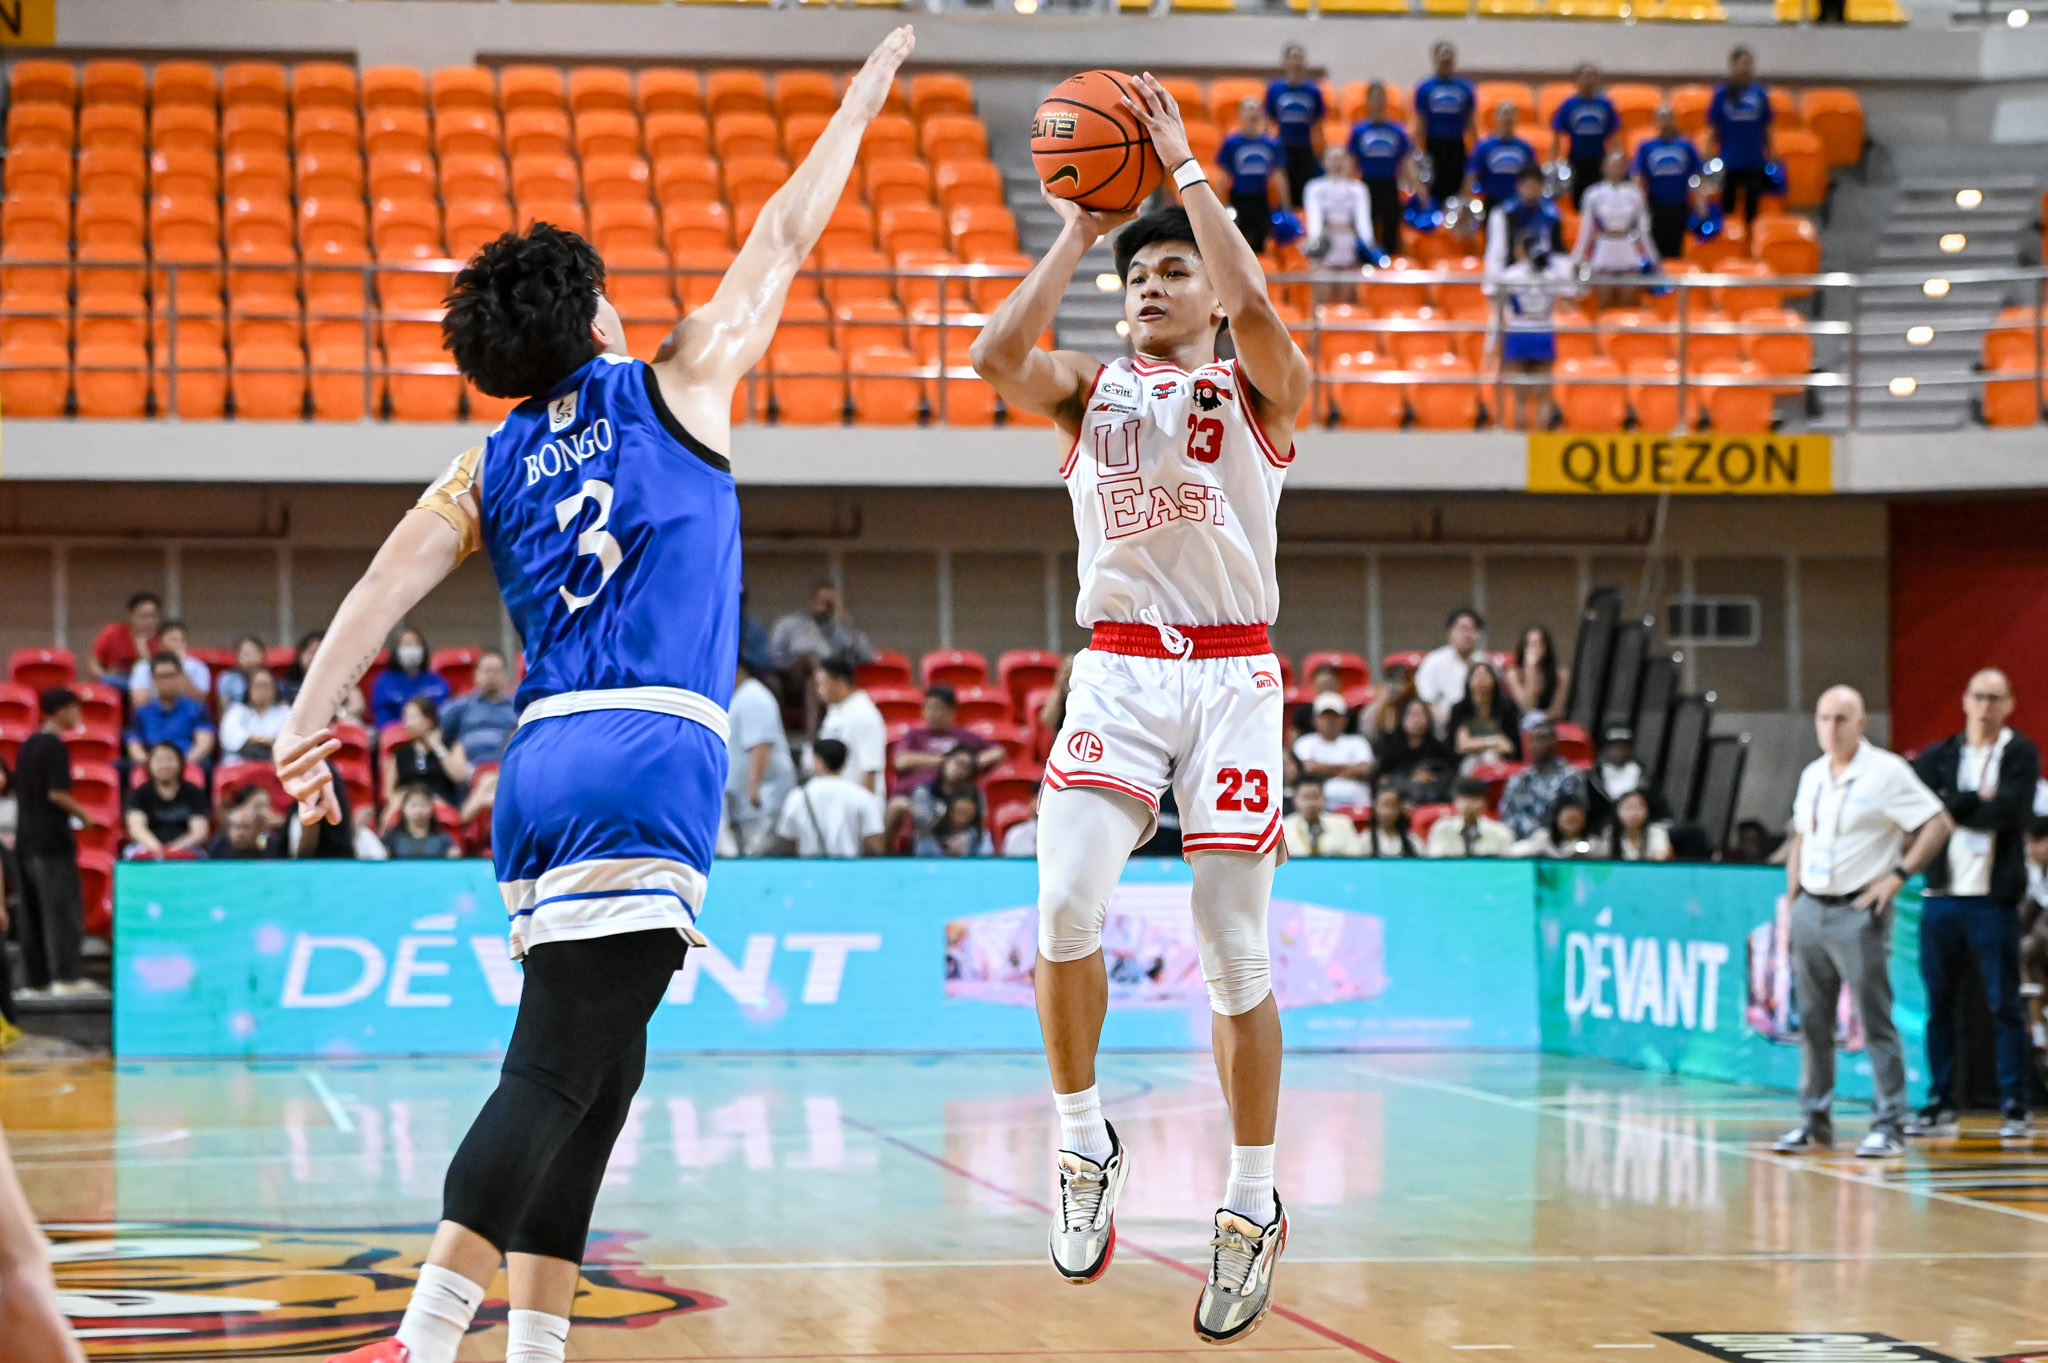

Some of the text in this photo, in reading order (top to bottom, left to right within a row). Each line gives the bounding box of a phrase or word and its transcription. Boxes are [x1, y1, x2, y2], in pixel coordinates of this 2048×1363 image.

[1103, 384, 1131, 398] C-vitt
[523, 418, 613, 487] BONGO
[1095, 419, 1140, 478] U
[1186, 412, 1225, 464] 23
[1561, 440, 1799, 491] QUEZON
[1097, 477, 1226, 540] EAST
[554, 478, 624, 614] 3
[1256, 679, 1272, 689] ANTA
[1216, 767, 1269, 813] 23
[1564, 907, 1729, 1033] DÉVANT
